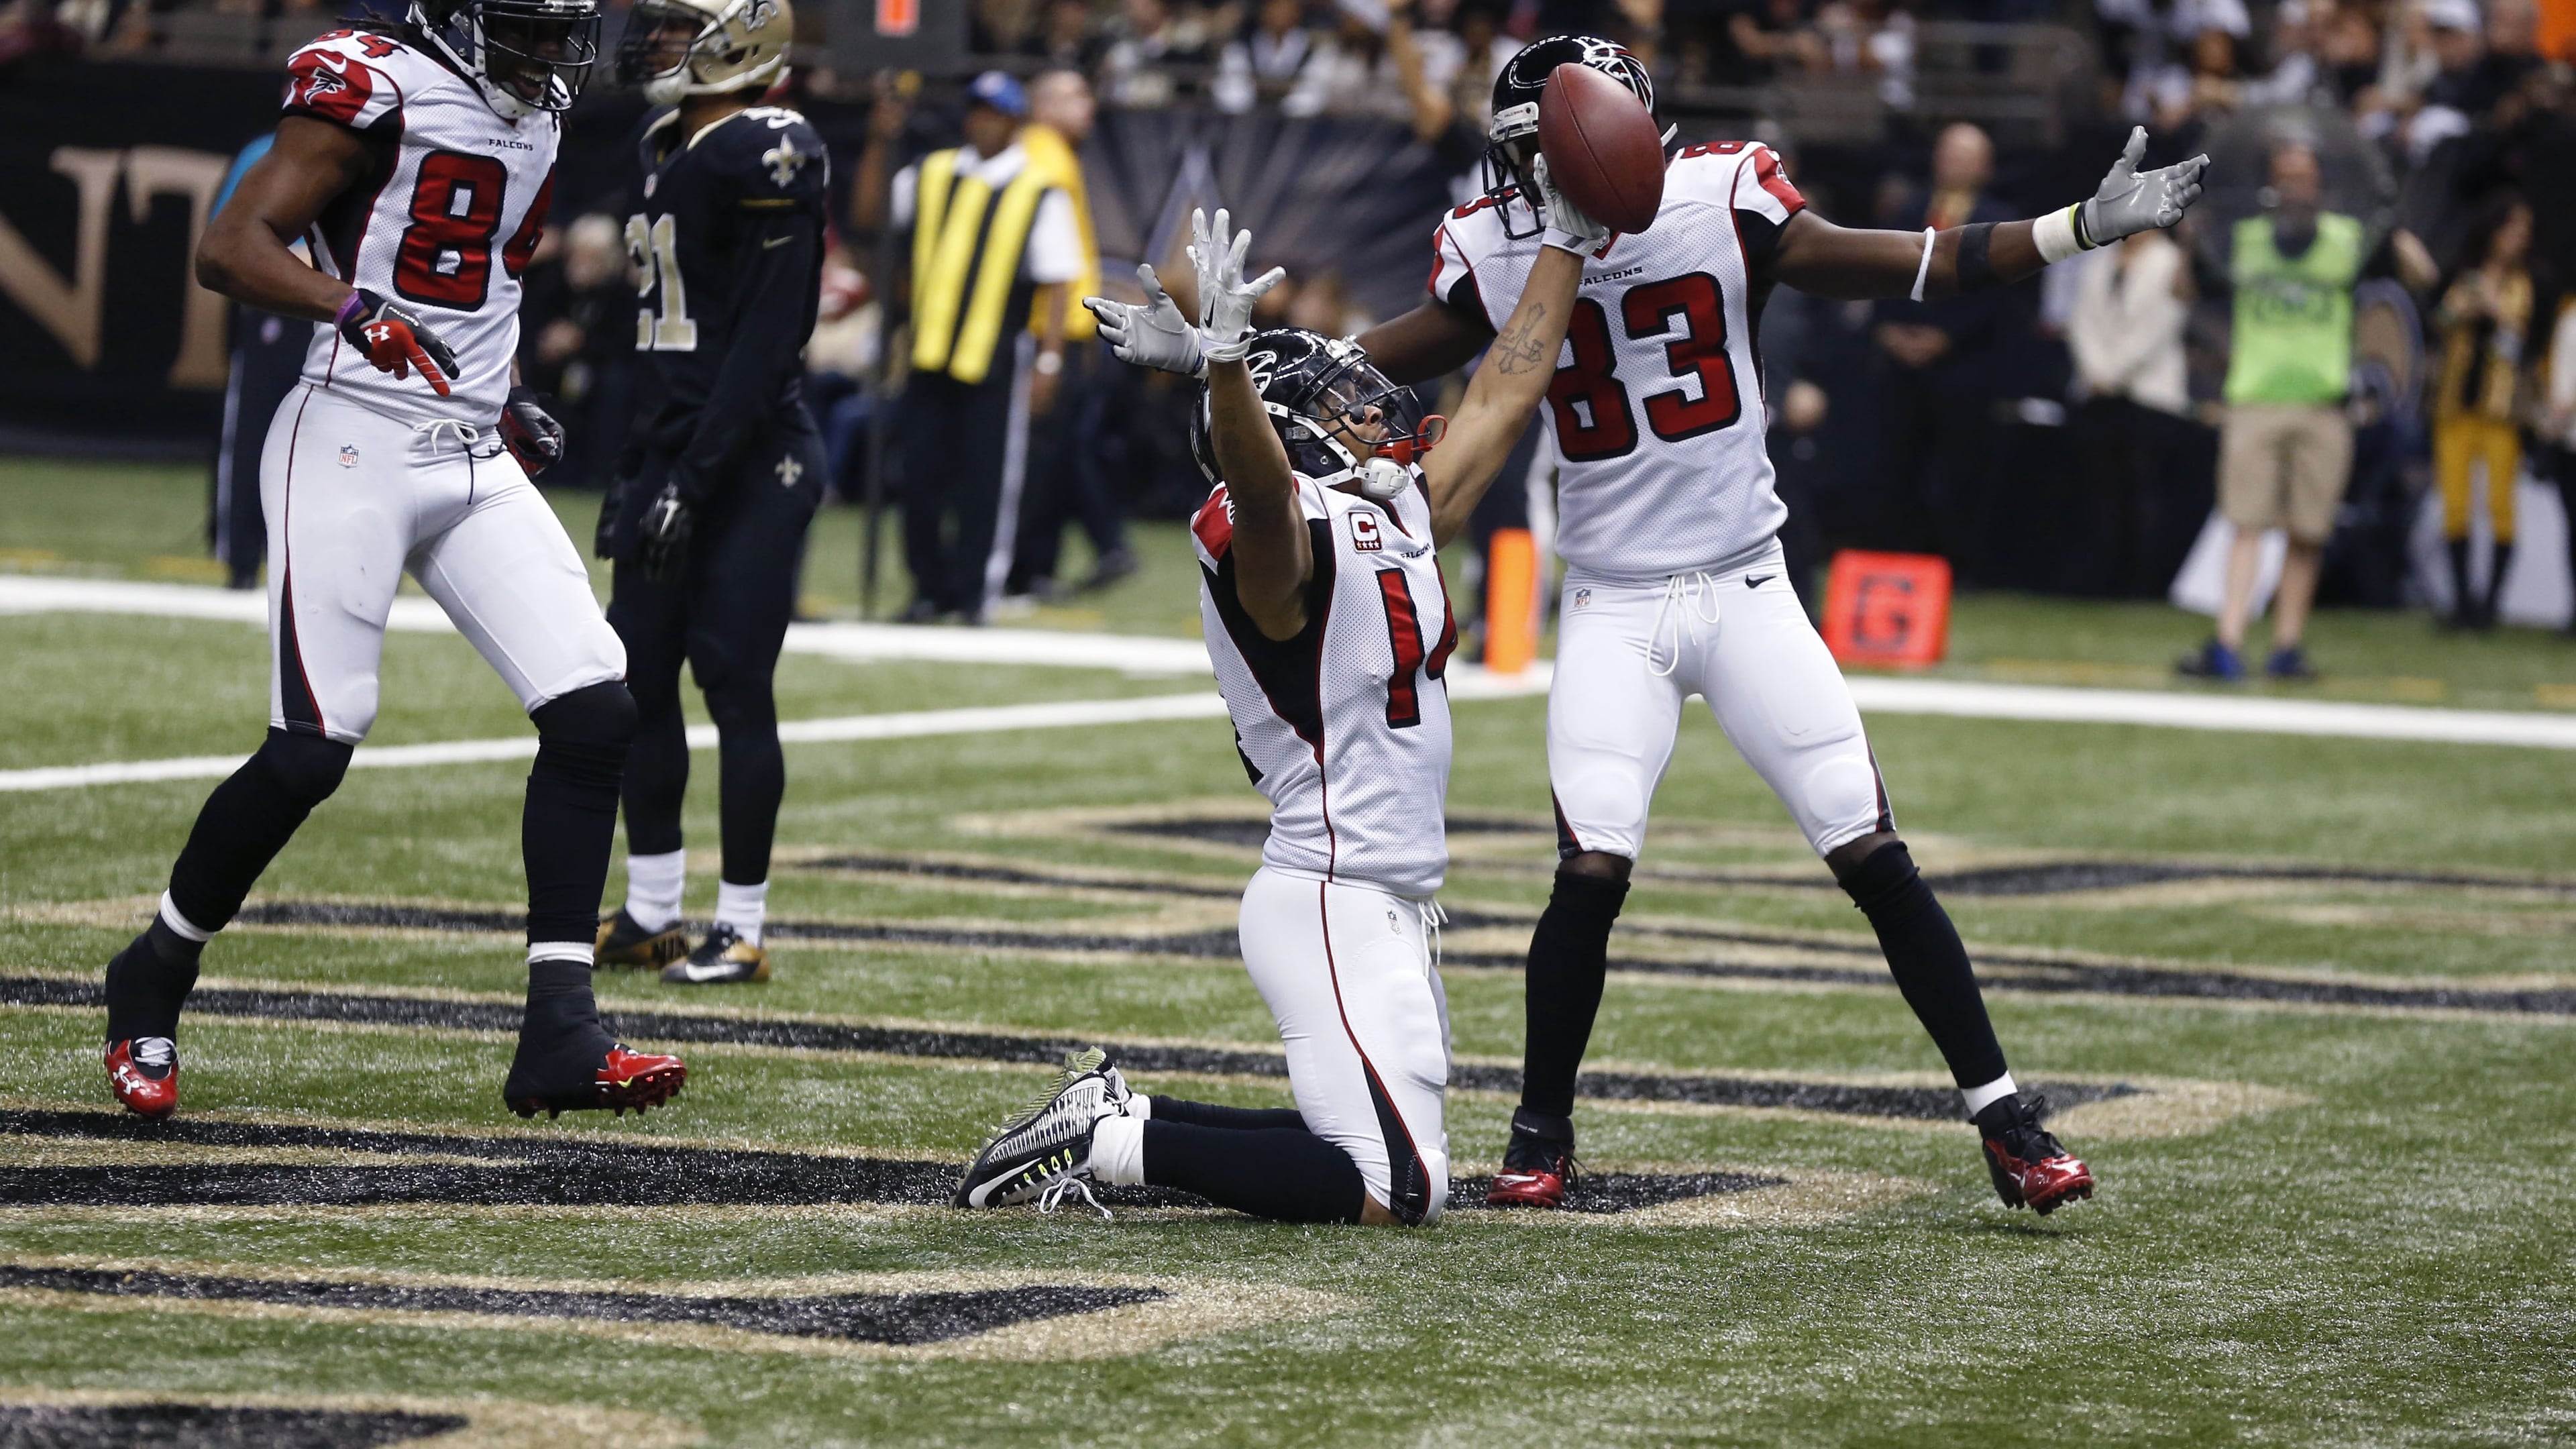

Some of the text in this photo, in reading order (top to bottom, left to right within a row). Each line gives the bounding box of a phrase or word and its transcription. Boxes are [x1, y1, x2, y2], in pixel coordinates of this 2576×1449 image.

[488, 138, 534, 152] FALCONS
[624, 212, 698, 352] 21
[387, 305, 421, 327] FALCONS
[1545, 271, 1740, 462] 83
[1350, 513, 1379, 541] C
[1851, 574, 1915, 654] G
